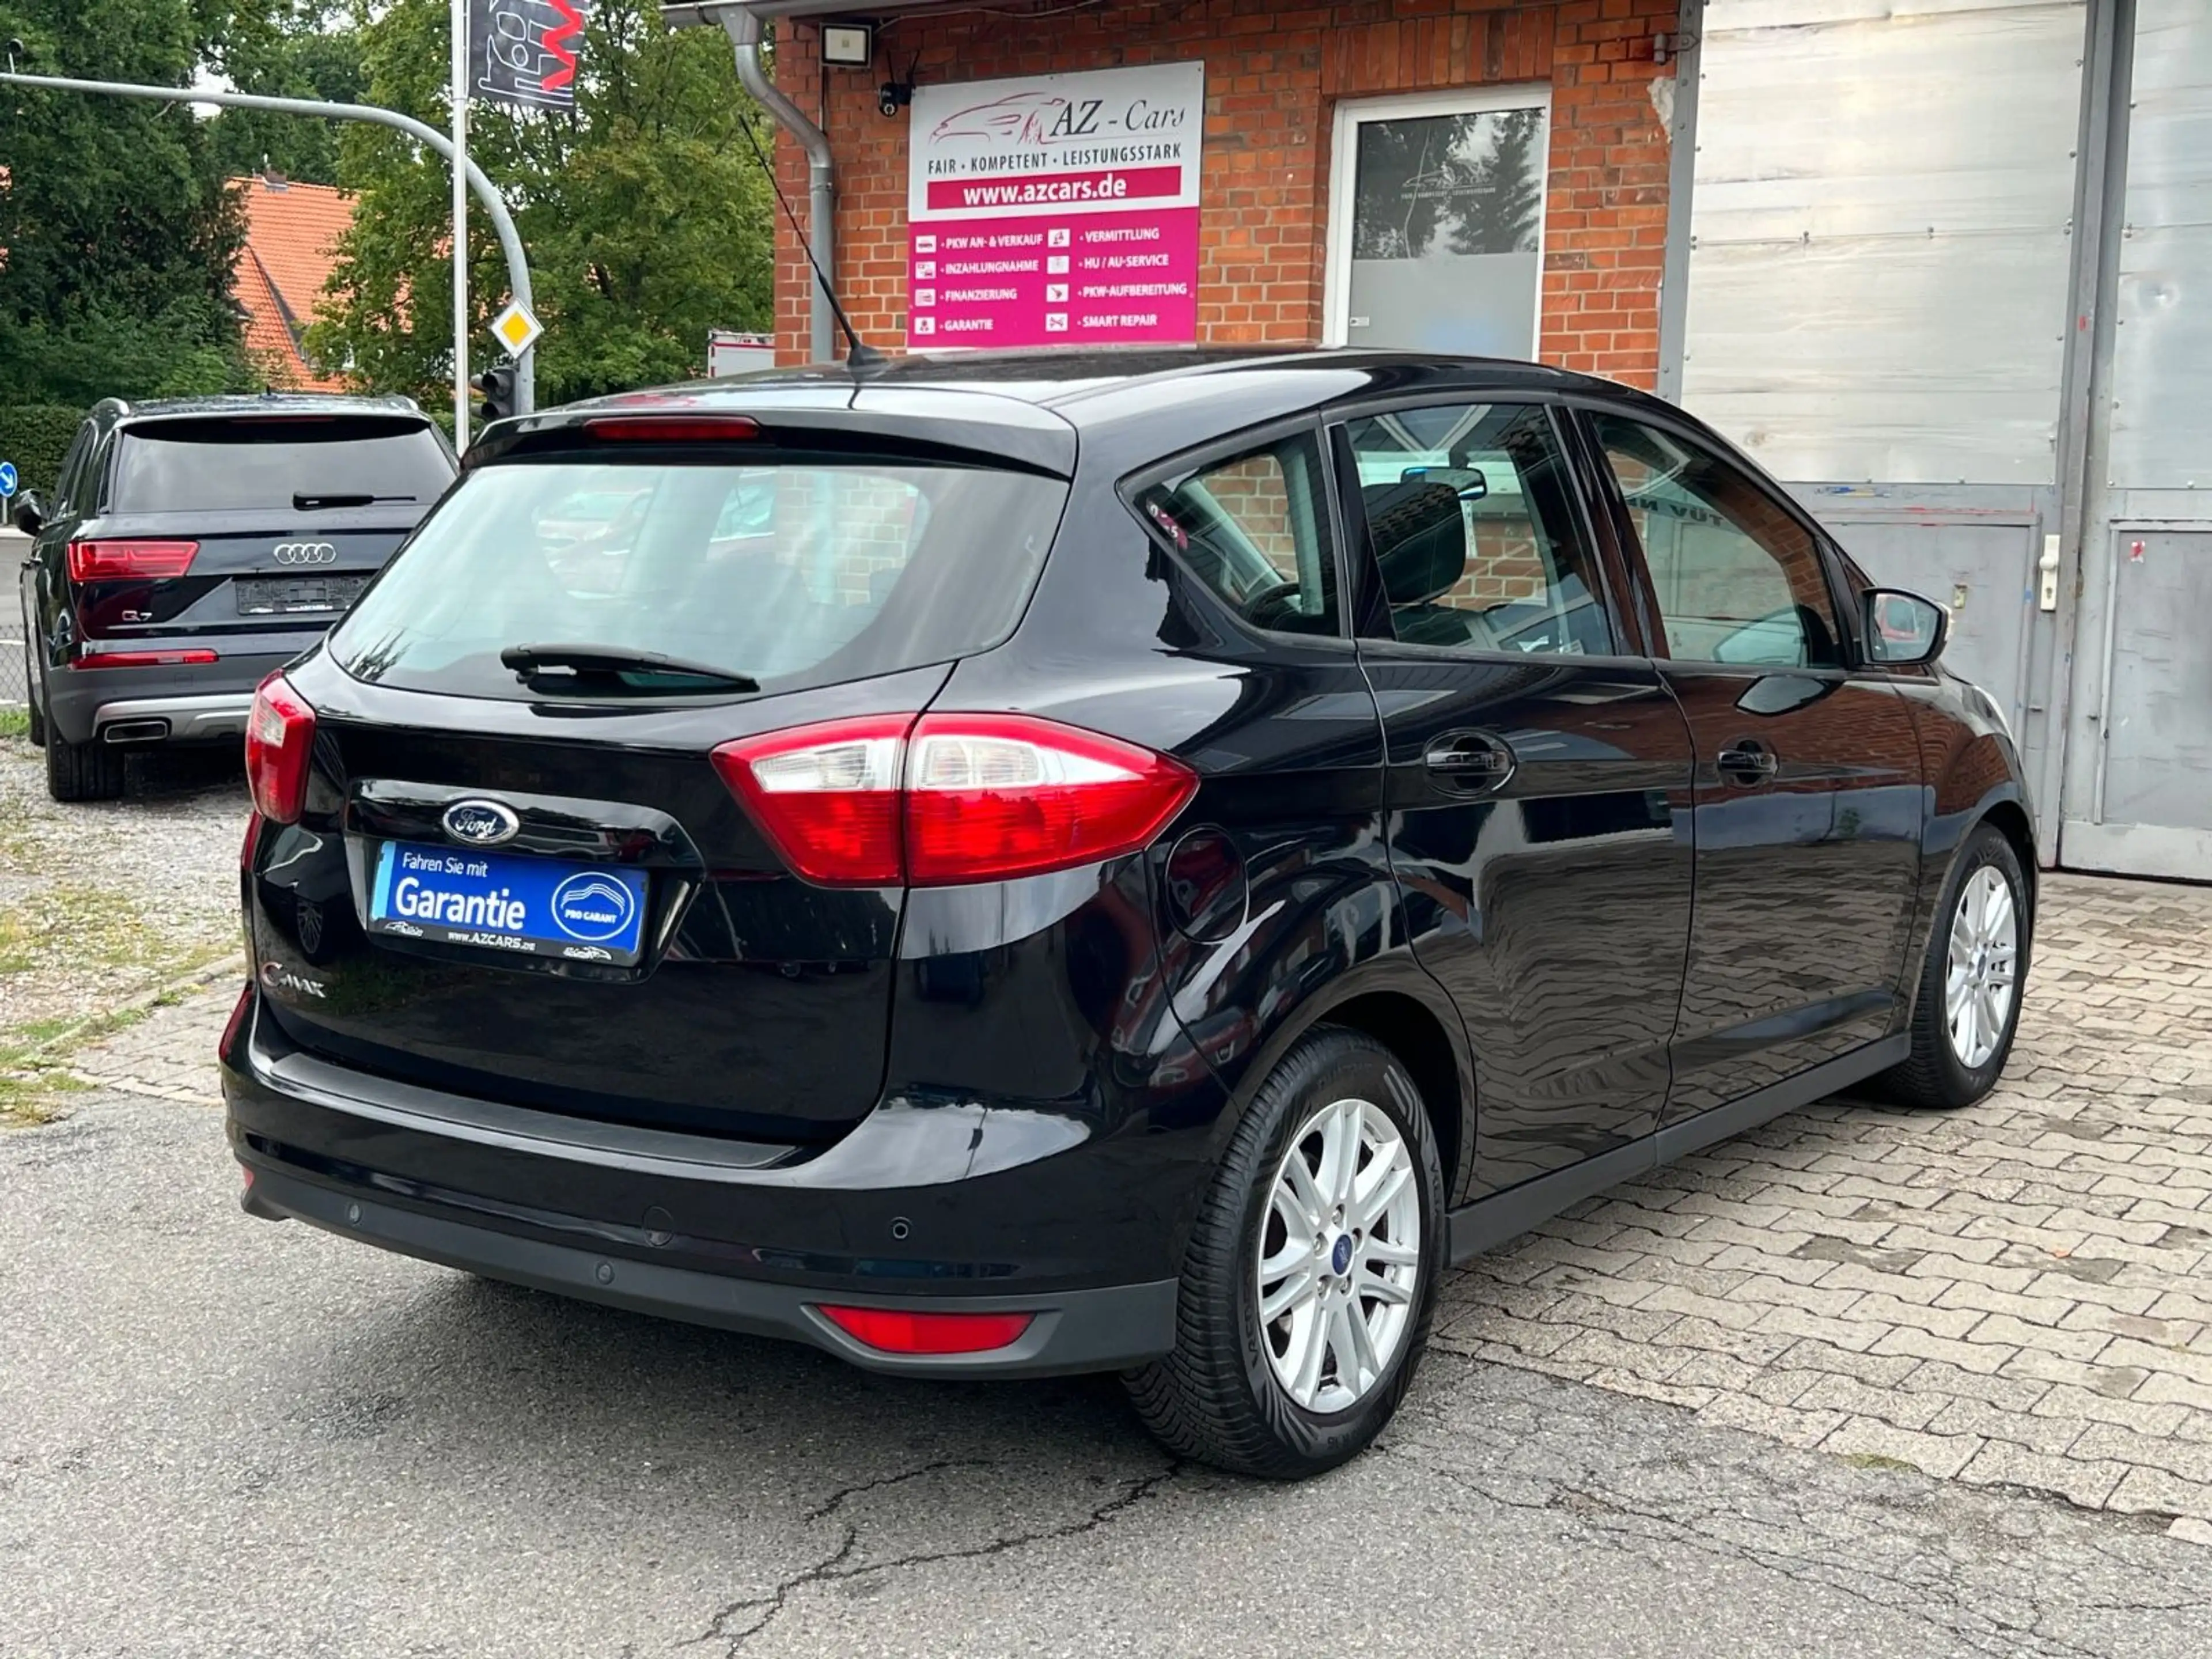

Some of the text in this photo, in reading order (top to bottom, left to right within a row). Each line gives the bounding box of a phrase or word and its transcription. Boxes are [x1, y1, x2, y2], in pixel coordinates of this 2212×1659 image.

[1050, 99, 1103, 137] AZ
[1125, 99, 1185, 131] Cars
[928, 142, 1181, 175] FAIR KOMPETENT LEISTUNGSSTARK
[963, 173, 1127, 206] www.azcars.de
[945, 238, 967, 249] PKW
[998, 233, 1043, 247] VERKAUF
[1085, 228, 1160, 243] VERMITTLUNG
[1084, 257, 1100, 269] HU
[1108, 254, 1169, 267] AU-SERVICE
[945, 289, 1017, 302] FINANZIERUNG
[1083, 283, 1187, 297] PKW-AUFBEREITUNG
[944, 319, 994, 331] GARANTIE
[1082, 314, 1157, 327] SMART REPAIR
[122, 610, 153, 622] Q7
[455, 808, 498, 835] Ford
[403, 852, 488, 878] Fahren Sie mit
[396, 877, 526, 930] Garantie
[565, 908, 617, 925] PRO GARANT
